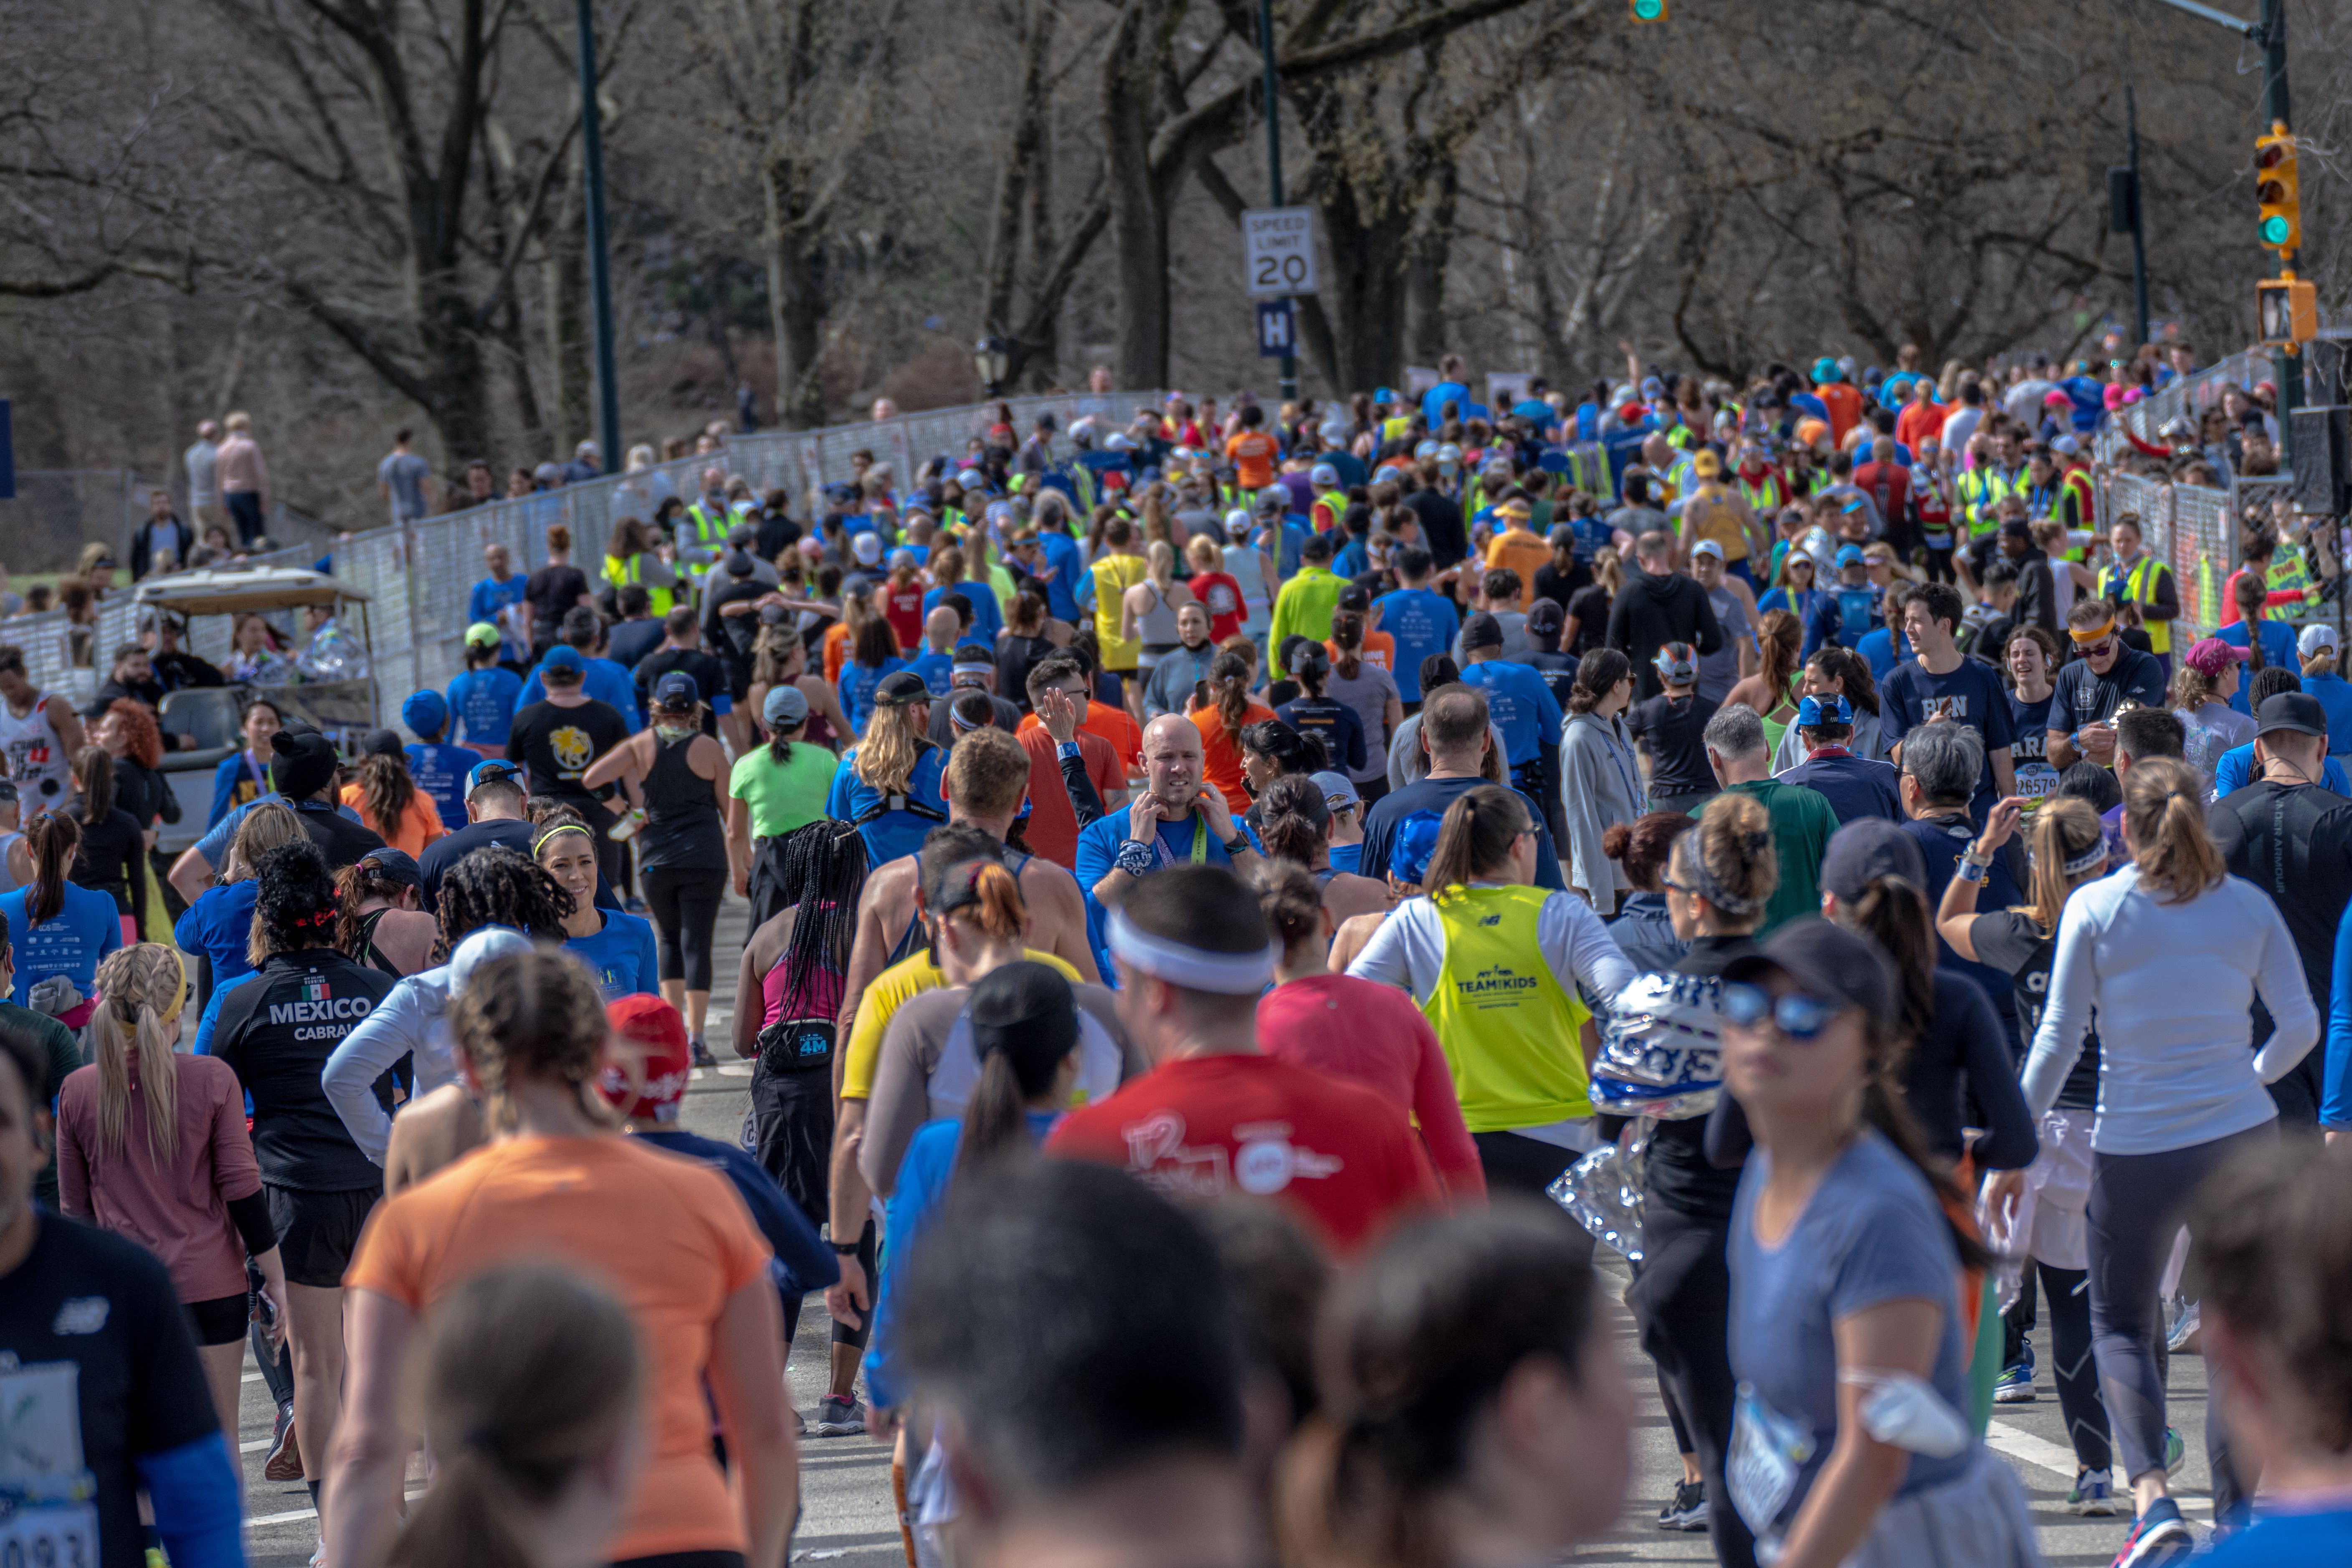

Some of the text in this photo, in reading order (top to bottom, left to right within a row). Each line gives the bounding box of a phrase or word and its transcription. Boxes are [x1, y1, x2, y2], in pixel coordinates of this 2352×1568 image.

[1252, 217, 1305, 231] SPEED
[1257, 235, 1299, 249] LIMIT
[1256, 255, 1306, 285] 20
[1263, 312, 1288, 346] H
[2018, 778, 2056, 795] 26579
[2274, 838, 2285, 893] ARMOUR
[1457, 976, 1537, 993] TEAM KIDS
[269, 997, 371, 1024] MEXICO
[800, 1040, 827, 1054] 4M
